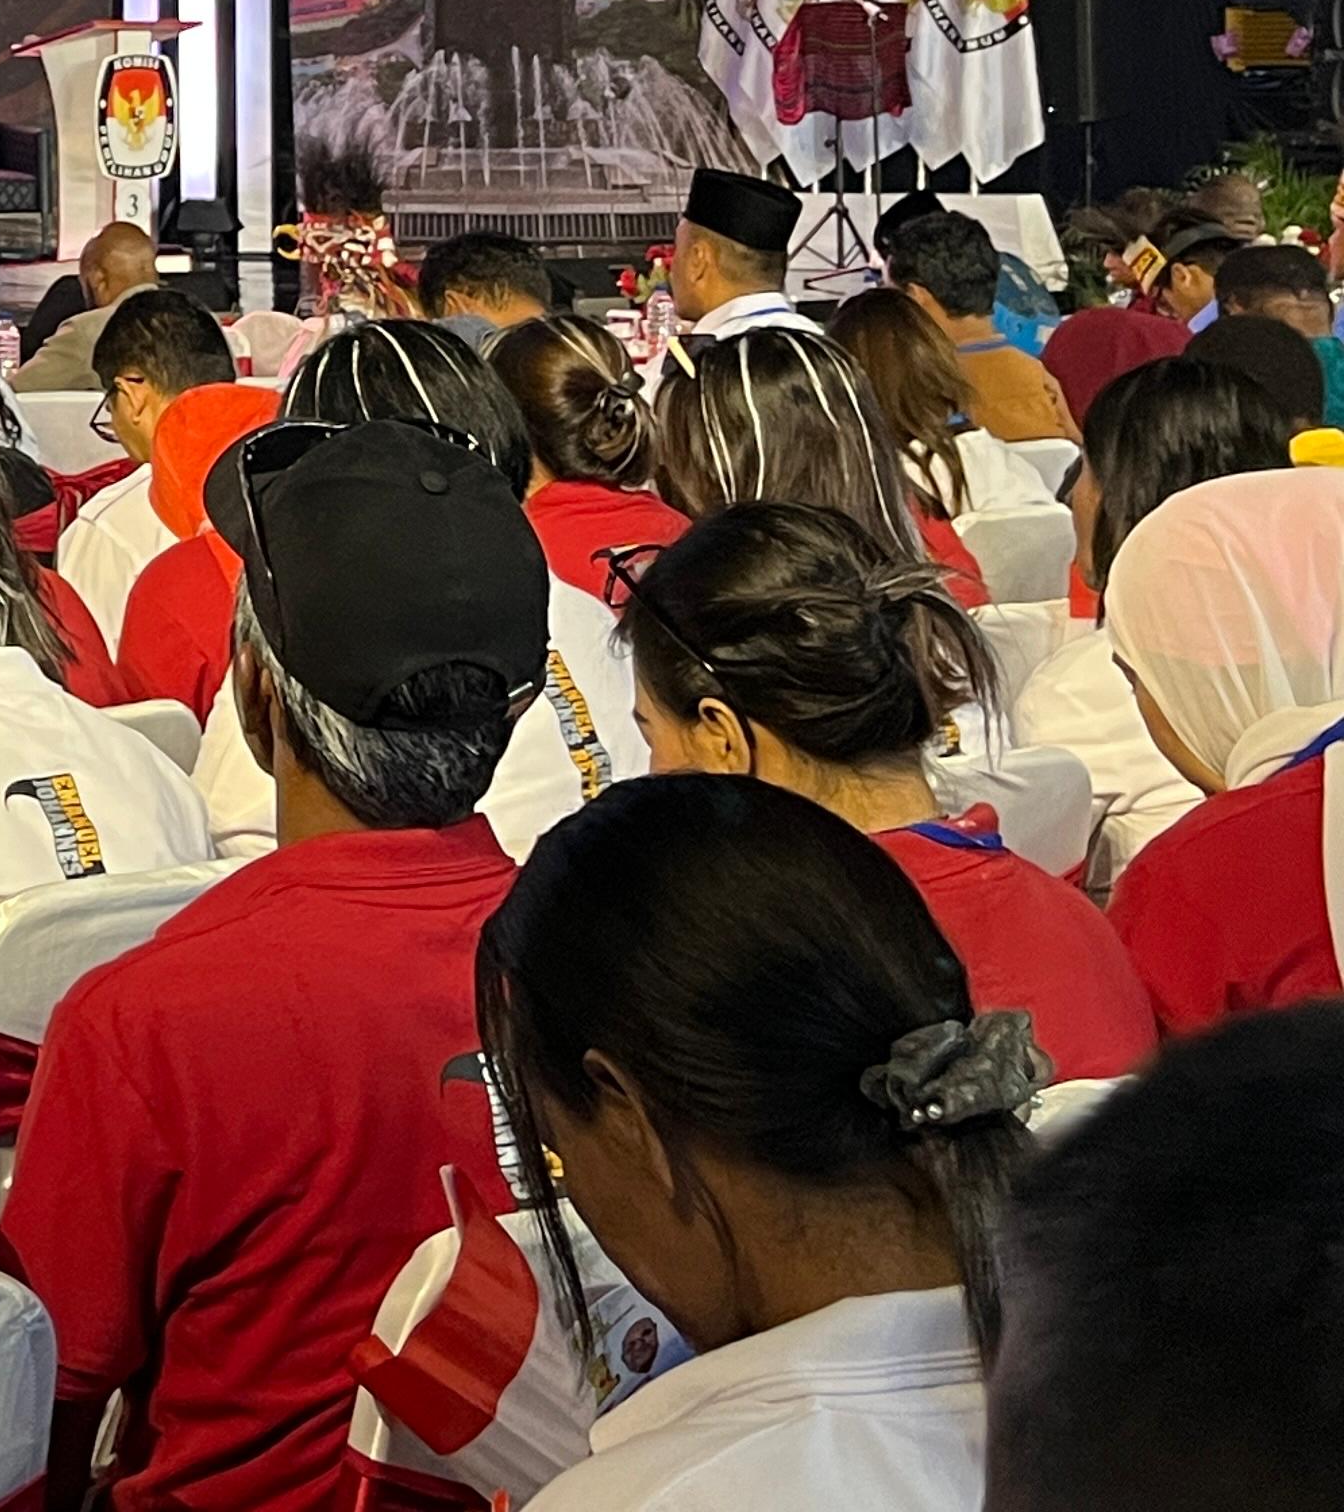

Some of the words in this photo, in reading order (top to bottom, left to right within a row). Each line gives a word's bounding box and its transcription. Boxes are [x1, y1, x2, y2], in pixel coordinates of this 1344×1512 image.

[113, 55, 160, 70] KOMISI
[125, 194, 139, 218] 3
[32, 778, 84, 876] JOHANNES
[52, 774, 102, 869] EMANUEL
